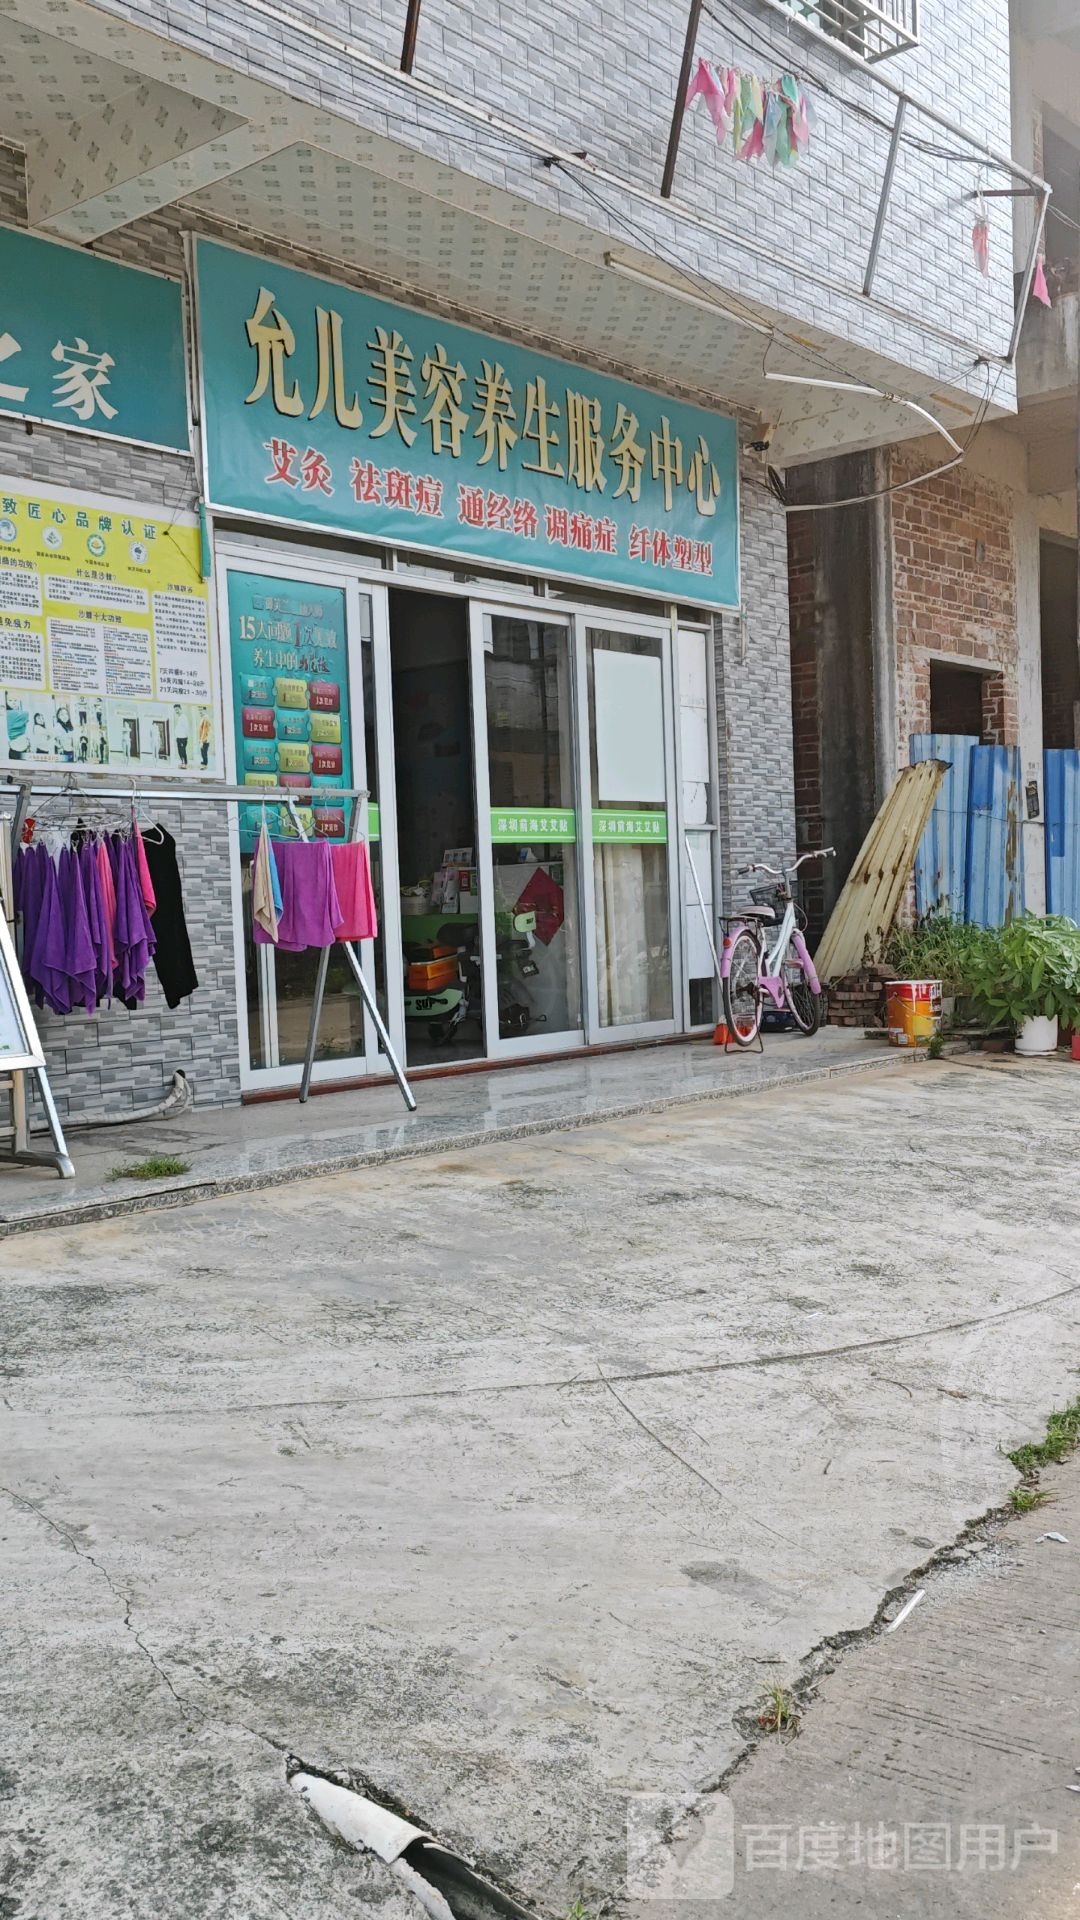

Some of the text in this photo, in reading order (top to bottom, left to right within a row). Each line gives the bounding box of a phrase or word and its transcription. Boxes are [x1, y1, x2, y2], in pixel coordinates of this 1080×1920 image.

[245, 286, 721, 517] 允儿美容养生服务中心
[2, 497, 157, 540] 致匠心品牌认证
[263, 437, 714, 577] 艾灸 祛斑痘 通经络 调痛症 纤体塑型
[497, 818, 568, 832] 深圳前海艾艾贴
